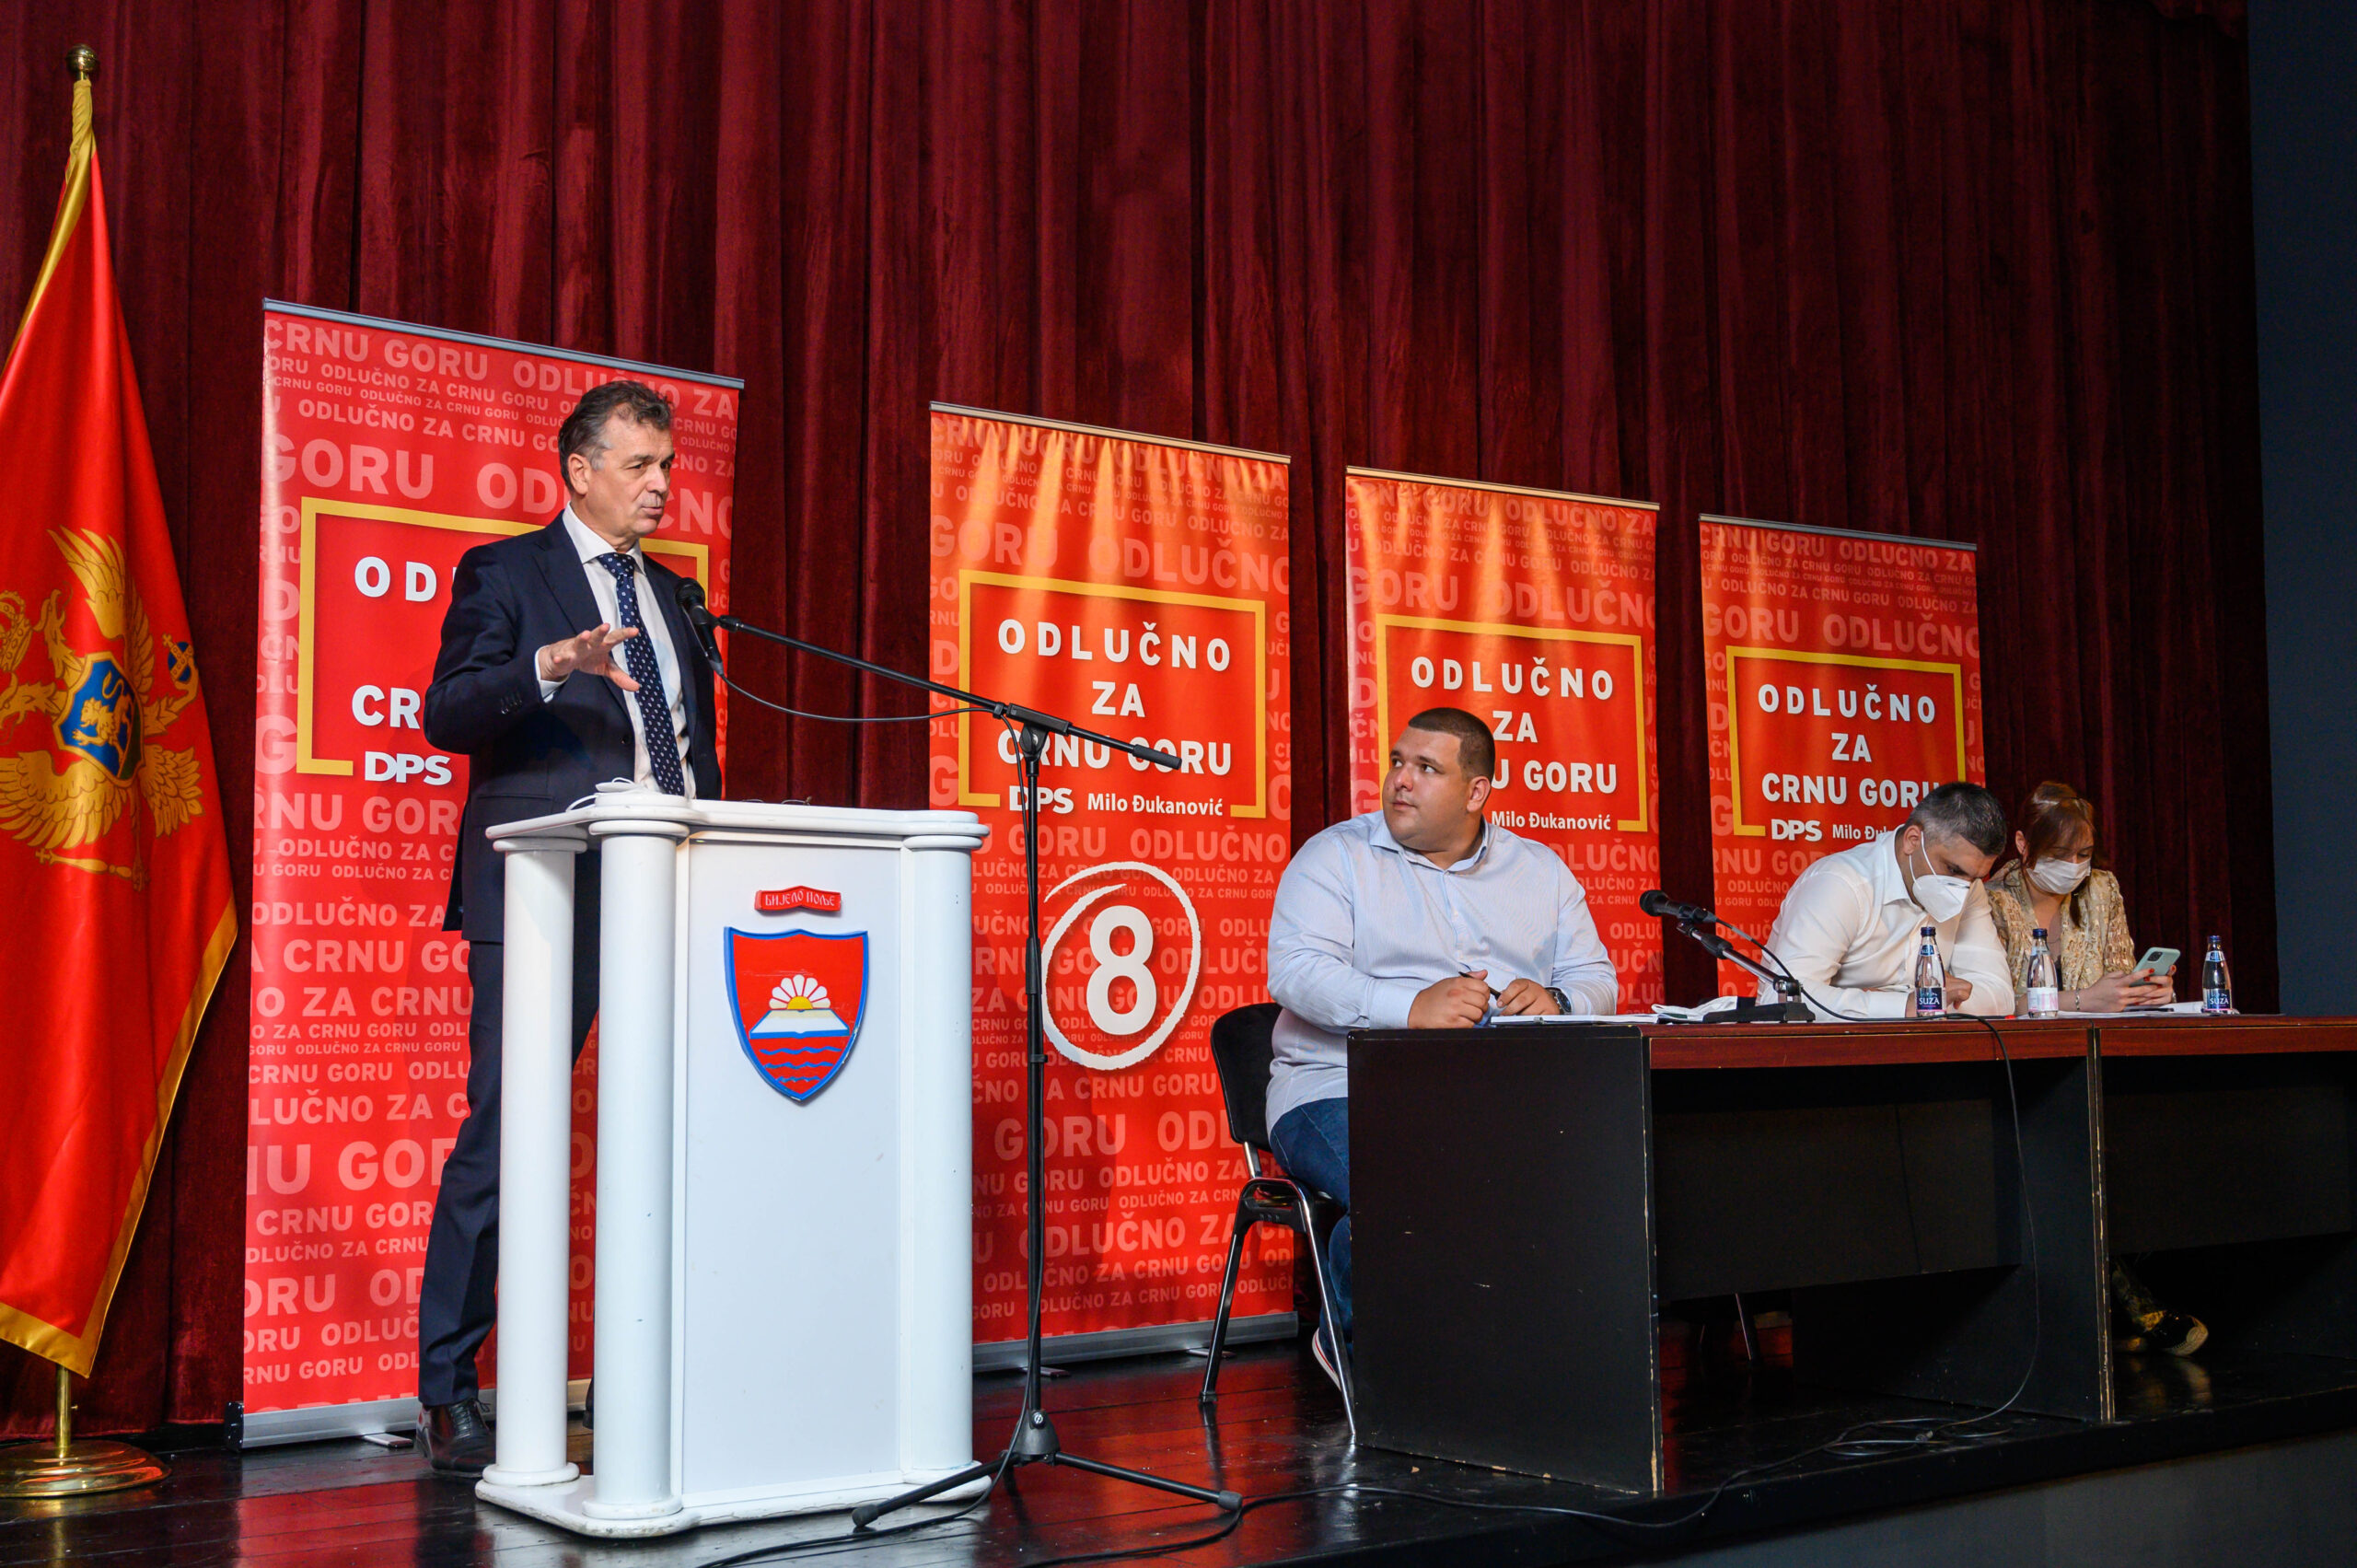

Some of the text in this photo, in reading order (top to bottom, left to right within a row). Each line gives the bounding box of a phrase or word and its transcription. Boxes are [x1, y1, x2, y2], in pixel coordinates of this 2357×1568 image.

[264, 319, 735, 421] CRNU GORU ZA
[321, 364, 410, 389] ODLUČNO
[416, 378, 439, 395] ZA
[447, 383, 494, 402] CRNU
[502, 391, 548, 411] GORU
[275, 377, 729, 452] CRNU GORU ODLUČNO ZA CRNU GORU ODLUČNO
[298, 400, 414, 431] ODLUČNO
[423, 417, 453, 438] ZA
[462, 424, 525, 447] CRNU
[938, 466, 965, 477] CRNU
[1066, 484, 1090, 494] CRNU
[1252, 464, 1286, 491] ZA
[1132, 508, 1177, 527] GORU
[1188, 515, 1264, 538] ODLUČNO
[1271, 526, 1288, 540] ZA
[1445, 517, 1459, 529] ZA
[1613, 538, 1643, 549] CRNU
[1506, 499, 1654, 536] ODLUČNO ZA
[931, 515, 1289, 595] GORU ODLUČNO
[1451, 548, 1469, 563] ZA
[1571, 559, 1638, 579] ODLUČNO
[1701, 525, 1973, 572] CRNU GORU ODLUČNO ZA
[1732, 553, 1961, 585] ODLUČNO ZA CRNU GORU ODLUČNO ZA CRNU
[1350, 566, 1458, 611] GORU
[1722, 578, 1978, 613] ODLUČNO ZA CRNU GORU ODLUČNO ZA
[998, 620, 1229, 671] ODLUČNO
[1704, 603, 1980, 657] GORU ODLUČNO
[1411, 656, 1612, 700] ODLUČNO
[352, 685, 421, 729] CR
[1092, 681, 1145, 717] ZA
[1759, 684, 1934, 724] ODLUČNO
[1492, 711, 1538, 743] ZA
[1831, 732, 1872, 762] ZA
[365, 751, 452, 784] DPS
[1524, 761, 1616, 794] GORU
[1009, 785, 1223, 816] DPS Milo Đukanović
[1762, 773, 1847, 805] CRNU
[1492, 810, 1611, 830] Milo Đukanović
[1771, 819, 1822, 842] DPS
[1833, 825, 1861, 839] Milo
[278, 836, 430, 861] ODLUČNO ZA
[1008, 824, 1286, 863] GORU ODLUČNO
[273, 863, 434, 880] GORU ODLUČNO ZA
[1172, 865, 1248, 883] ODLUČNO
[1254, 870, 1274, 883] ZA
[1640, 878, 1655, 890] ZA
[1728, 878, 1789, 893] ODLUČNO
[765, 890, 803, 906] БИЈЕЛО
[1199, 889, 1248, 898] ZA CRNU
[1589, 895, 1634, 904] ZA CRNU
[1725, 898, 1751, 906] GORU
[252, 896, 444, 927] ODLUČNO ZA
[284, 940, 404, 972] CRNU
[1086, 906, 1156, 1035] 8
[302, 986, 473, 1016] ZA CRNU
[273, 1023, 416, 1040] ZA CRNU GORU
[1179, 1031, 1203, 1040] GORU
[296, 1042, 460, 1054] ODLUČNO ZA CRNU GORU
[1165, 1047, 1208, 1063] CRNU
[249, 1063, 393, 1084] CRNU GORU
[1075, 1073, 1216, 1099] CRNU GORU
[387, 1095, 433, 1120] ZA
[1099, 1157, 1242, 1189] ODLUČNO ZA
[998, 1189, 1208, 1218] ZA GORU ODLUČNO ZA
[256, 1206, 353, 1236] CRNU
[342, 1241, 366, 1258] ZA
[1097, 1257, 1188, 1282] ZA CRNU
[1111, 1287, 1179, 1307] ZA CRNU
[321, 1310, 419, 1346] ODLUČ
[299, 1357, 363, 1379] GORU
